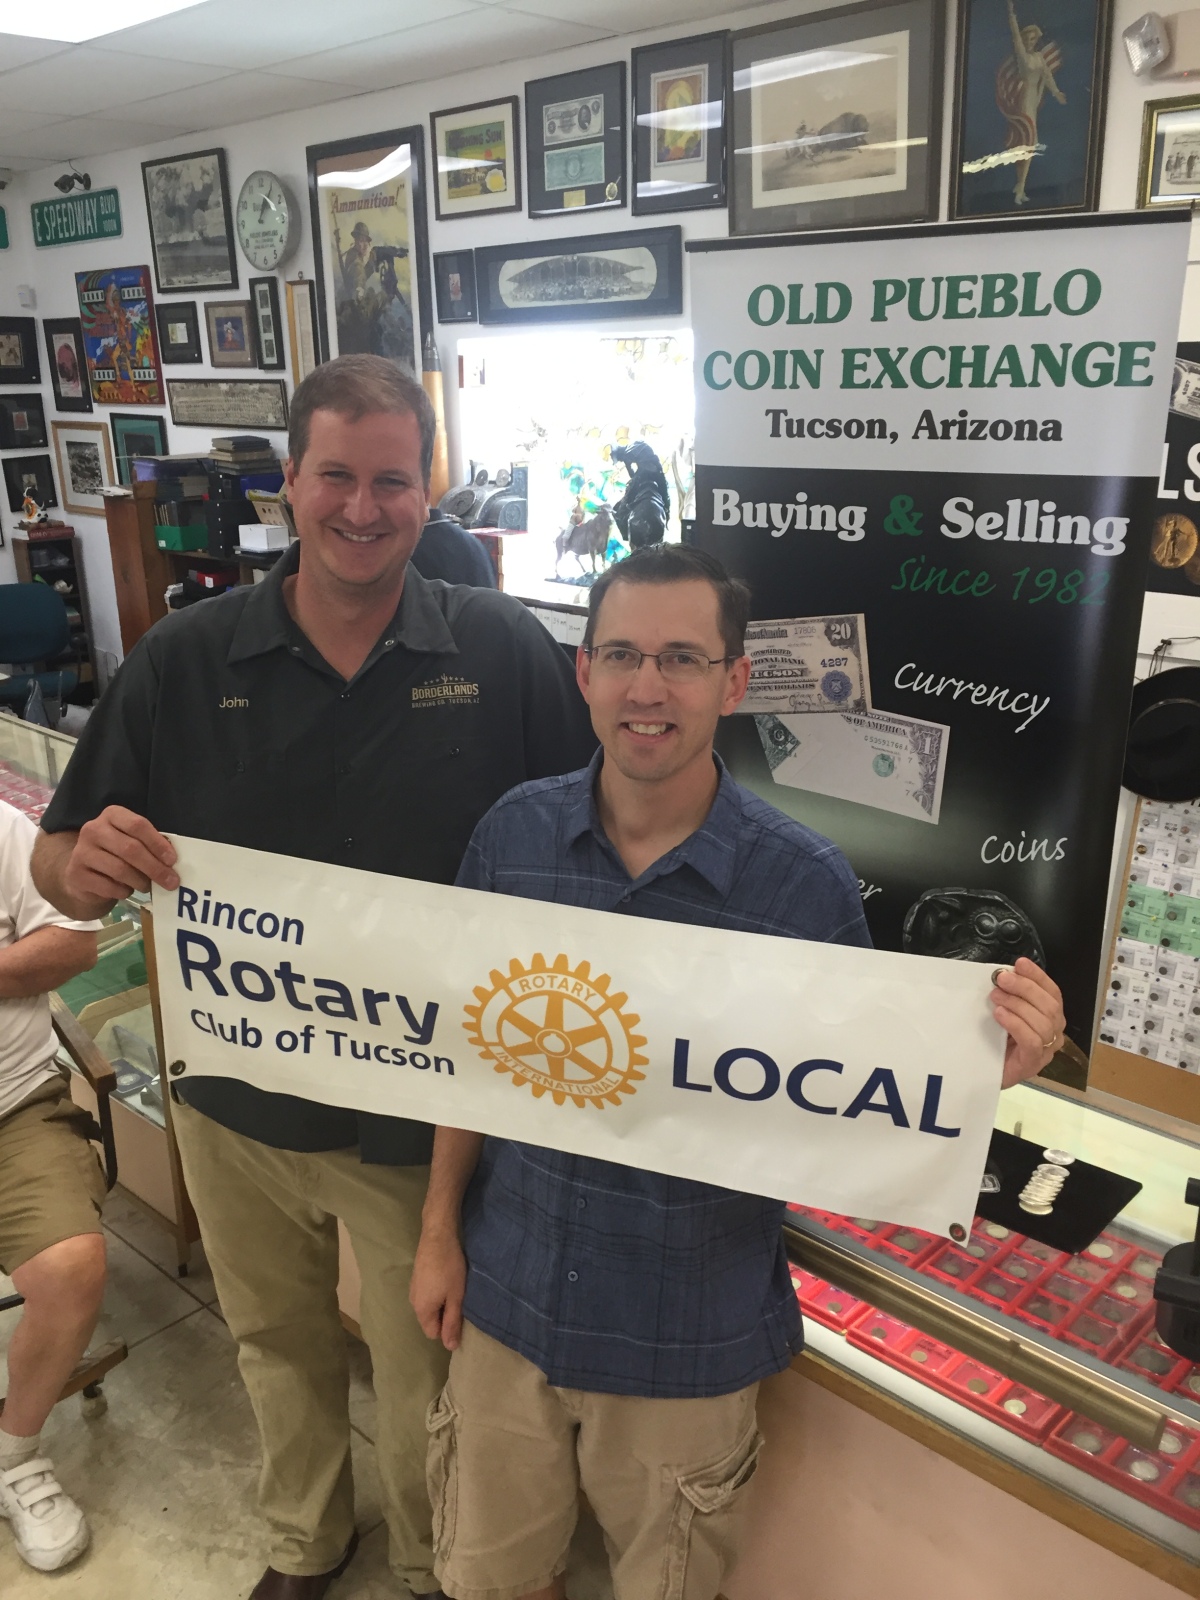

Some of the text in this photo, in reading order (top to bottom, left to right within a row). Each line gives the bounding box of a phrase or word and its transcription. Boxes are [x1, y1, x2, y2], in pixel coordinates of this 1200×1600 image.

[331, 184, 404, 214] "Ammunition!"
[34, 194, 116, 242] E SPEEDWAY BLVD
[263, 256, 268, 266] 6
[273, 249, 278, 260] 5
[747, 268, 1102, 326] OLD PUEBLO
[702, 341, 1156, 390] COIN EXCHANGE
[765, 409, 1063, 445] Tucson, Arizona
[711, 488, 1131, 557] Buying & Selling
[891, 555, 1110, 605] Since 1982
[794, 626, 816, 635] 17806
[830, 622, 852, 641] 20
[820, 657, 849, 668] 4287
[219, 696, 249, 708] John
[411, 683, 479, 700] BORDERLANDS
[411, 700, 436, 708] BREWING
[894, 663, 1050, 733] Currency
[853, 717, 866, 726] OF
[867, 720, 907, 736] AMERICA
[981, 830, 1068, 864] Coins
[177, 886, 305, 946] Rincon
[176, 928, 439, 1046] Rotary
[518, 975, 597, 1002] ROTARY
[190, 1009, 455, 1076] Club of Tucson
[496, 1051, 620, 1095] INTERNATIONAL
[671, 1037, 962, 1138] LOCAL
